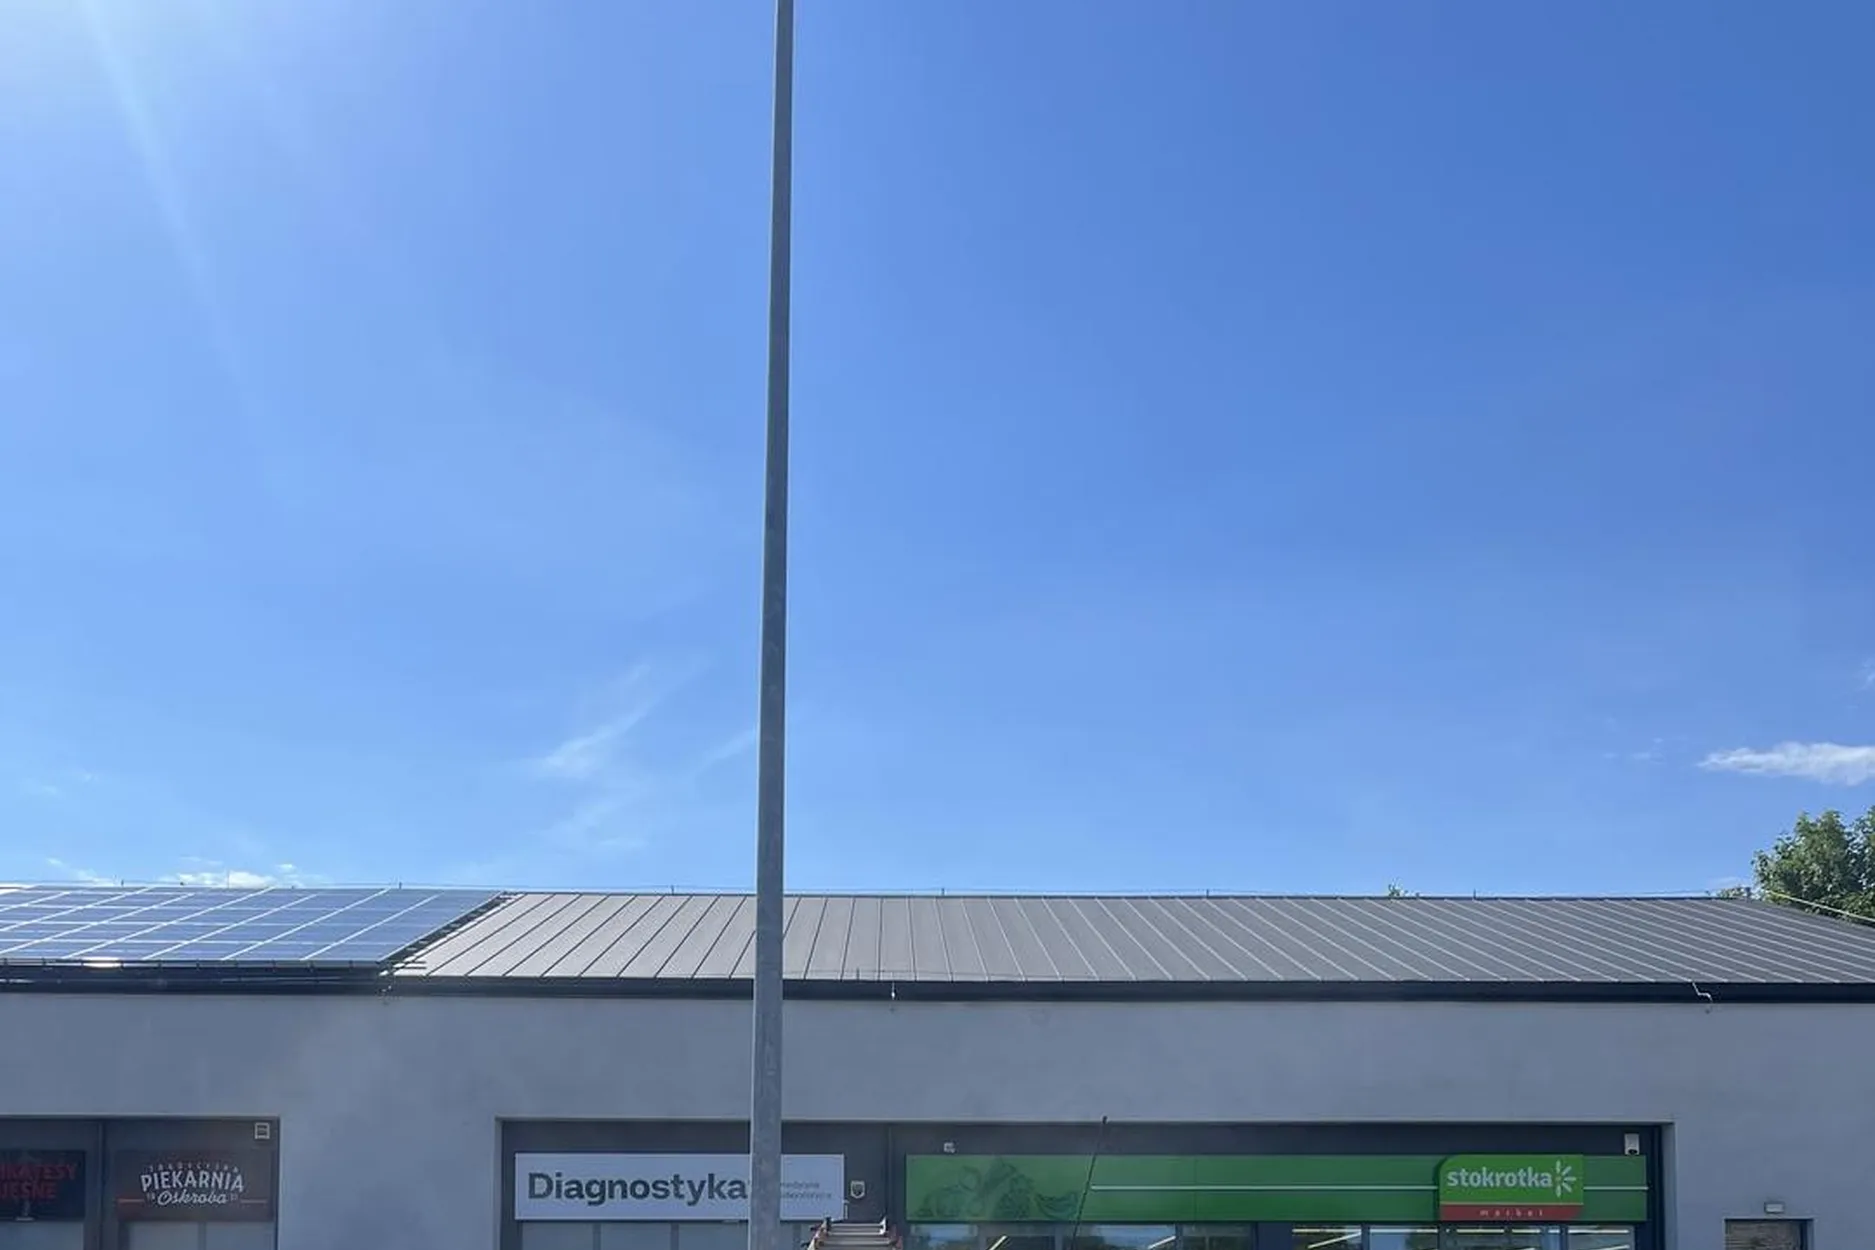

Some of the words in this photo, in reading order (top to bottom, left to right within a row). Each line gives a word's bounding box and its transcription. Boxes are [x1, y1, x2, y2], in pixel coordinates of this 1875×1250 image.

[140, 1169, 244, 1192] PIEKARNIA
[1447, 1166, 1553, 1188] stokrotka
[157, 1188, 227, 1206] Oskroba
[527, 1172, 749, 1206] Diagnostyka
